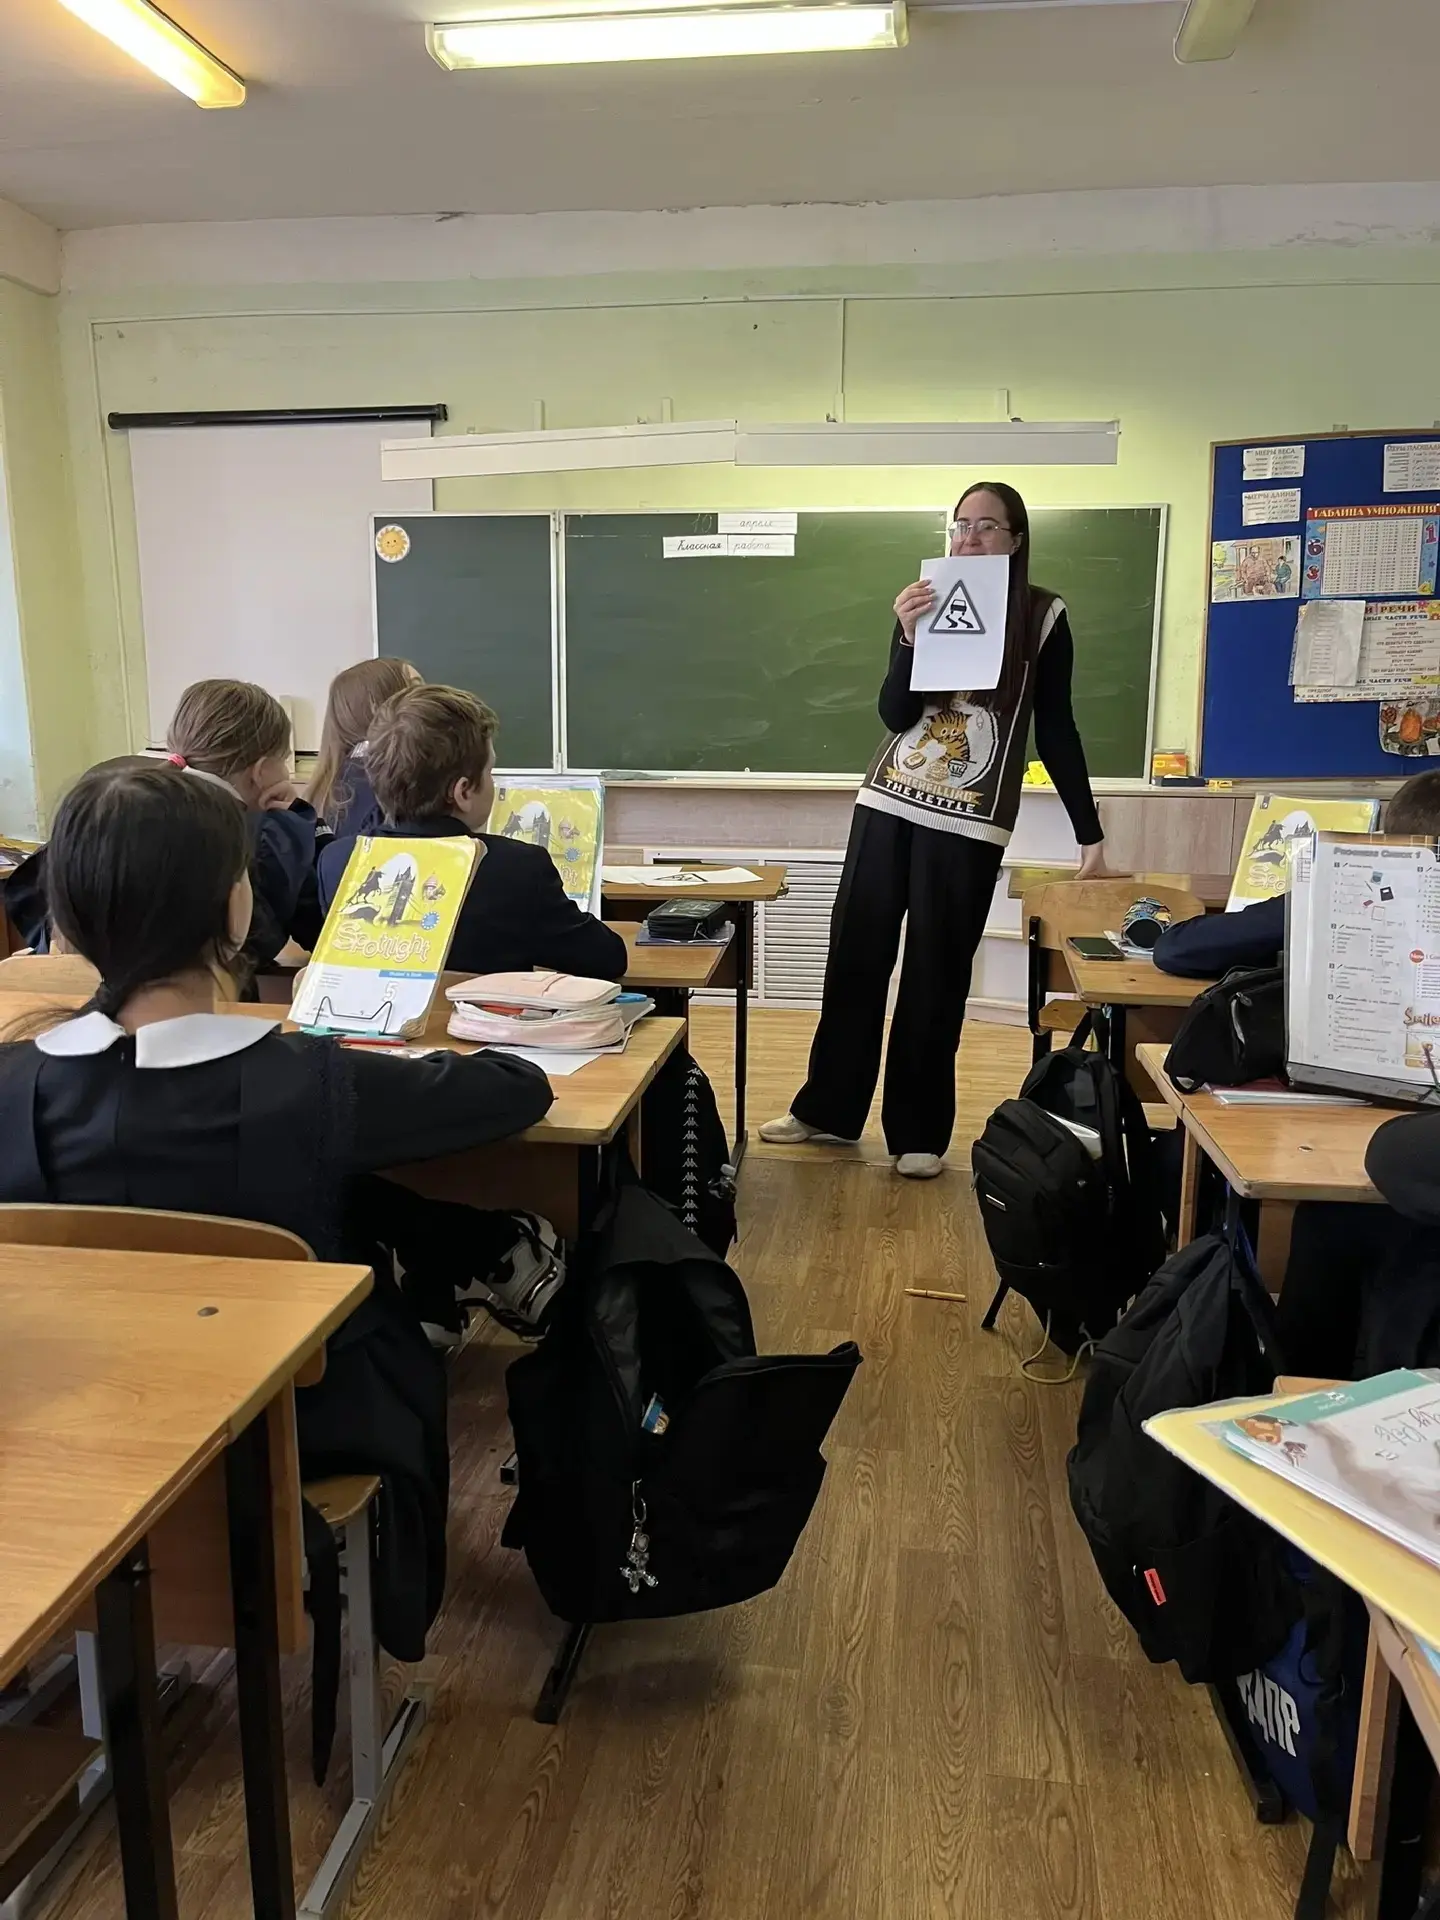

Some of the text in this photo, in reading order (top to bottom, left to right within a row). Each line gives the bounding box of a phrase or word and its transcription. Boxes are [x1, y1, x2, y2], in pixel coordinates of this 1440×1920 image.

[1314, 506, 1437, 518] ТАБЛИЦА УМНОЖЕНИЯ
[677, 538, 770, 552] Классная работа
[1379, 605, 1416, 613] РЕЧИ
[886, 779, 976, 813] THE KETTLE
[332, 921, 432, 963] Spotlight
[383, 982, 400, 1002] 5
